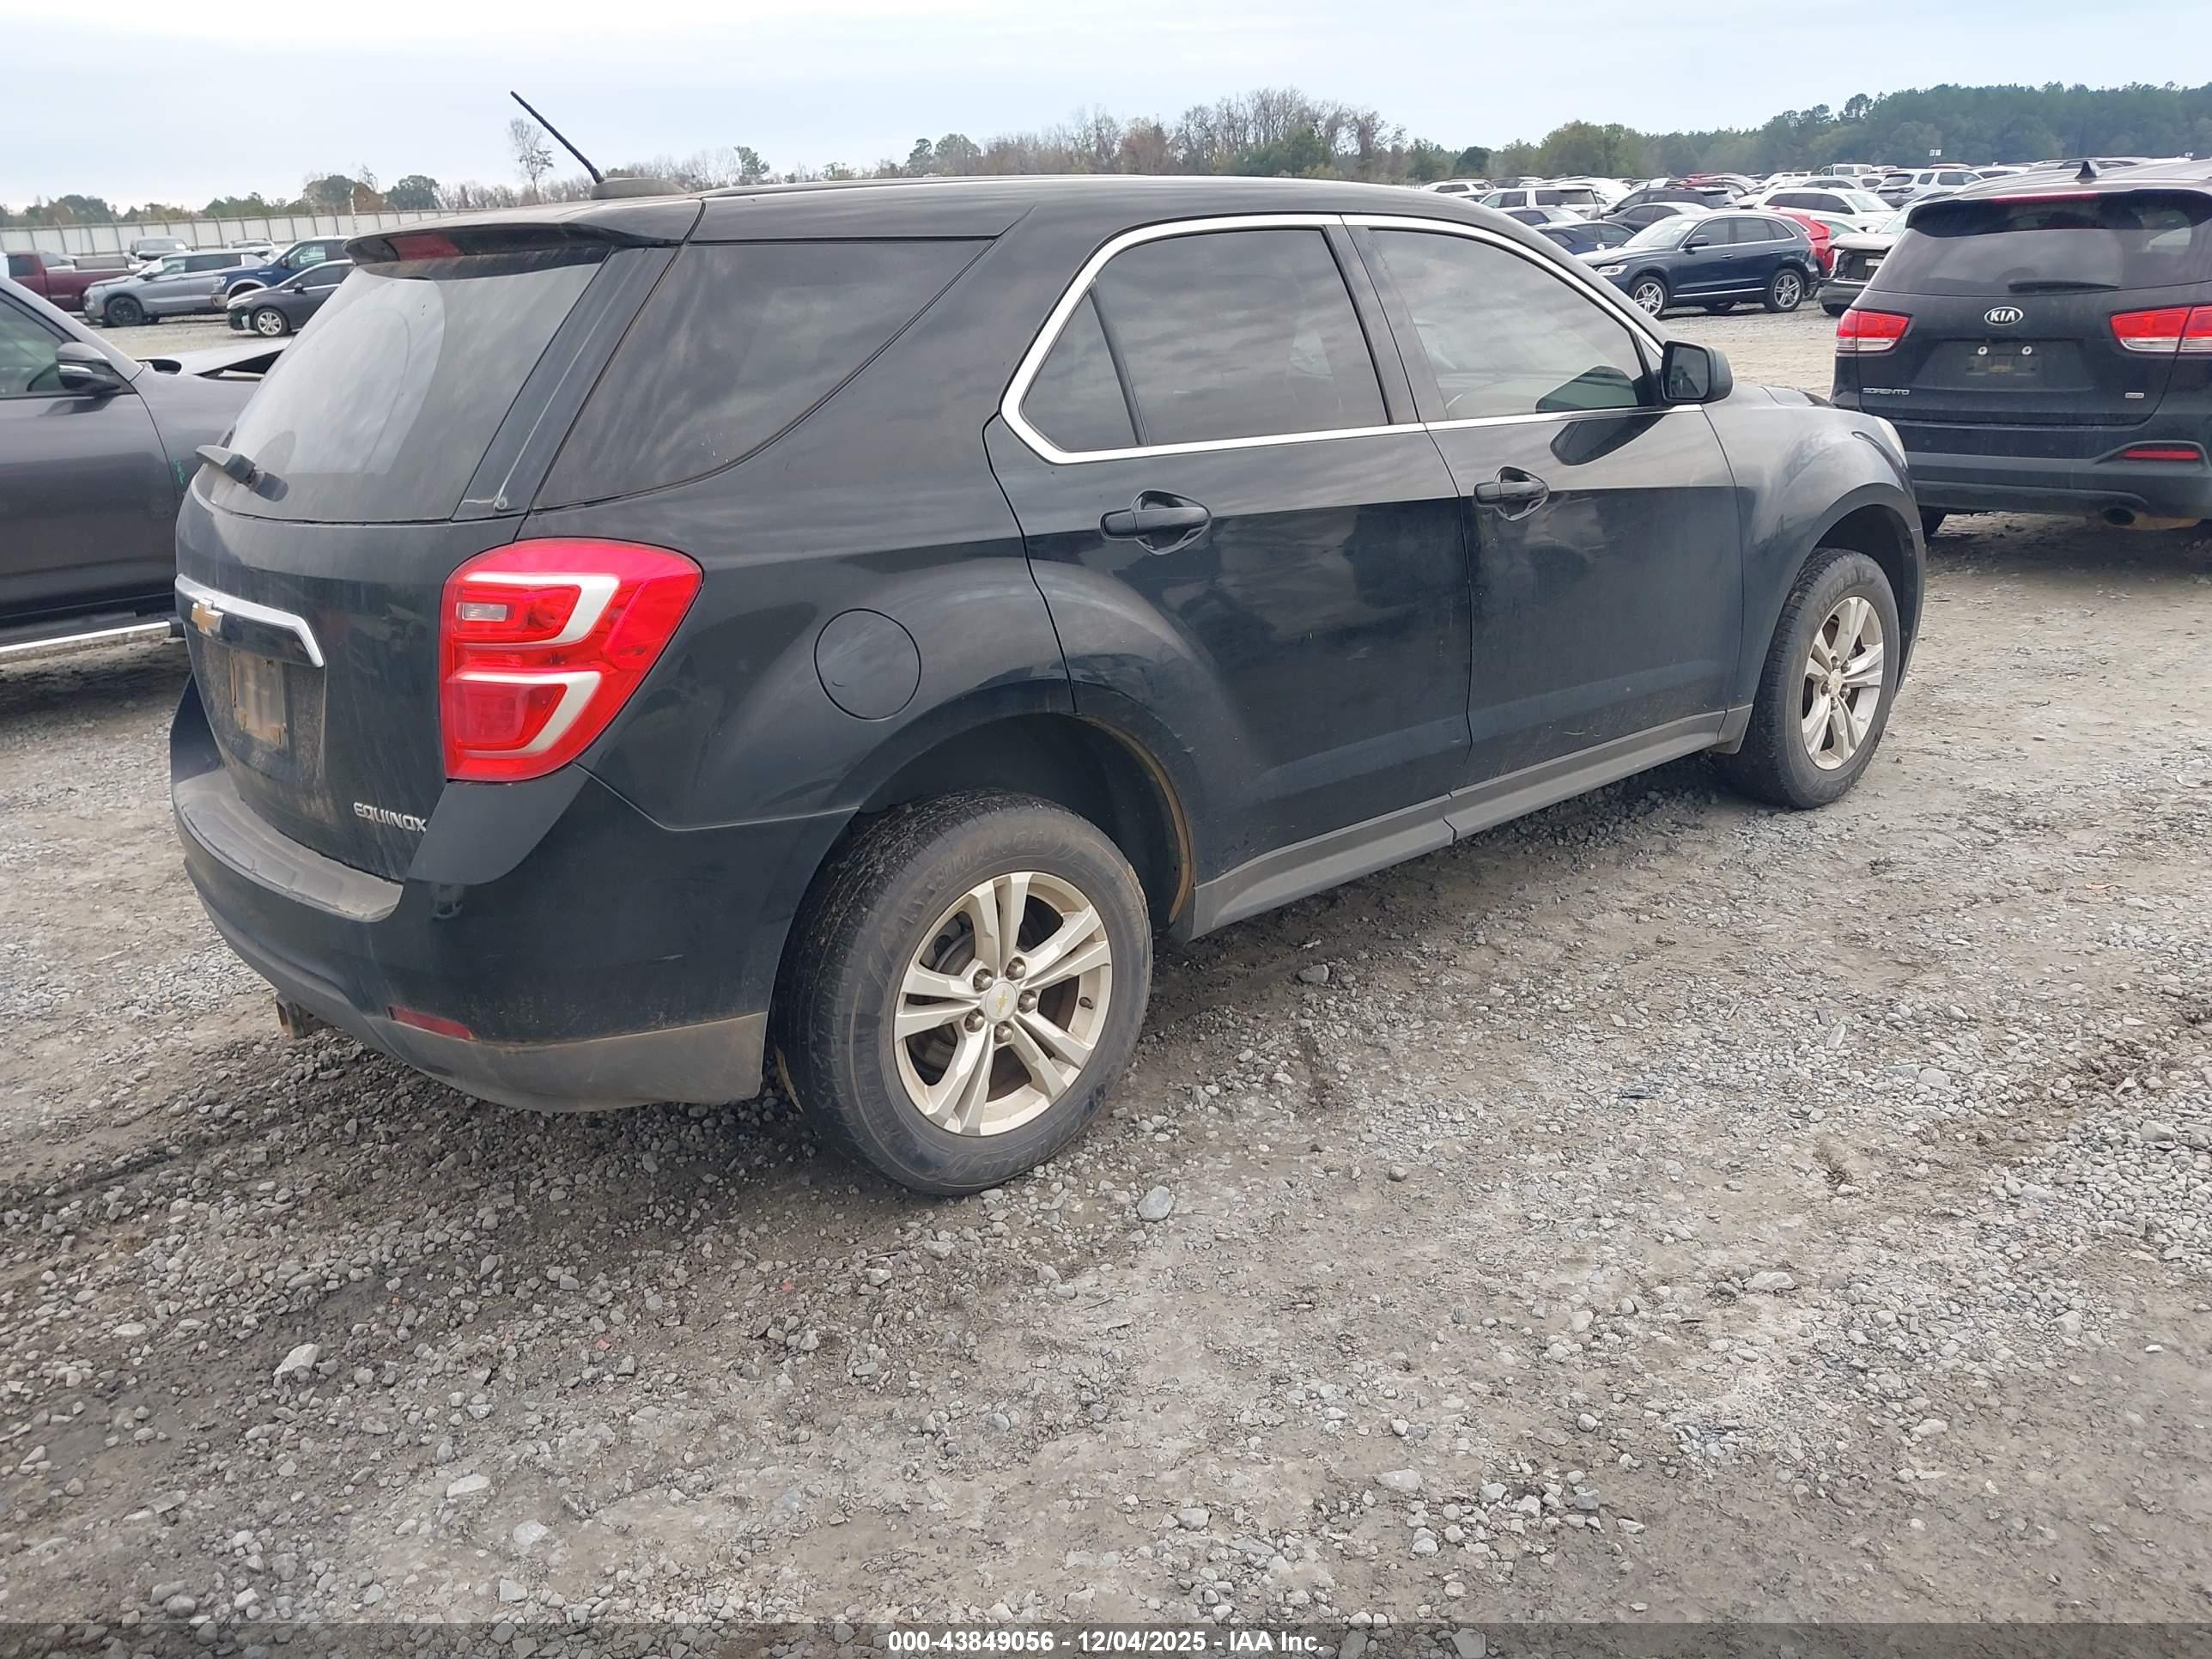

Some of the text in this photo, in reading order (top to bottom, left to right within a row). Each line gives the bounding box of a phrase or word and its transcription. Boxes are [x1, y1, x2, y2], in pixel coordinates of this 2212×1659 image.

[1990, 310, 2016, 322] KIA
[1862, 387, 1911, 396] SORENTO
[353, 801, 427, 832] EQUINOX
